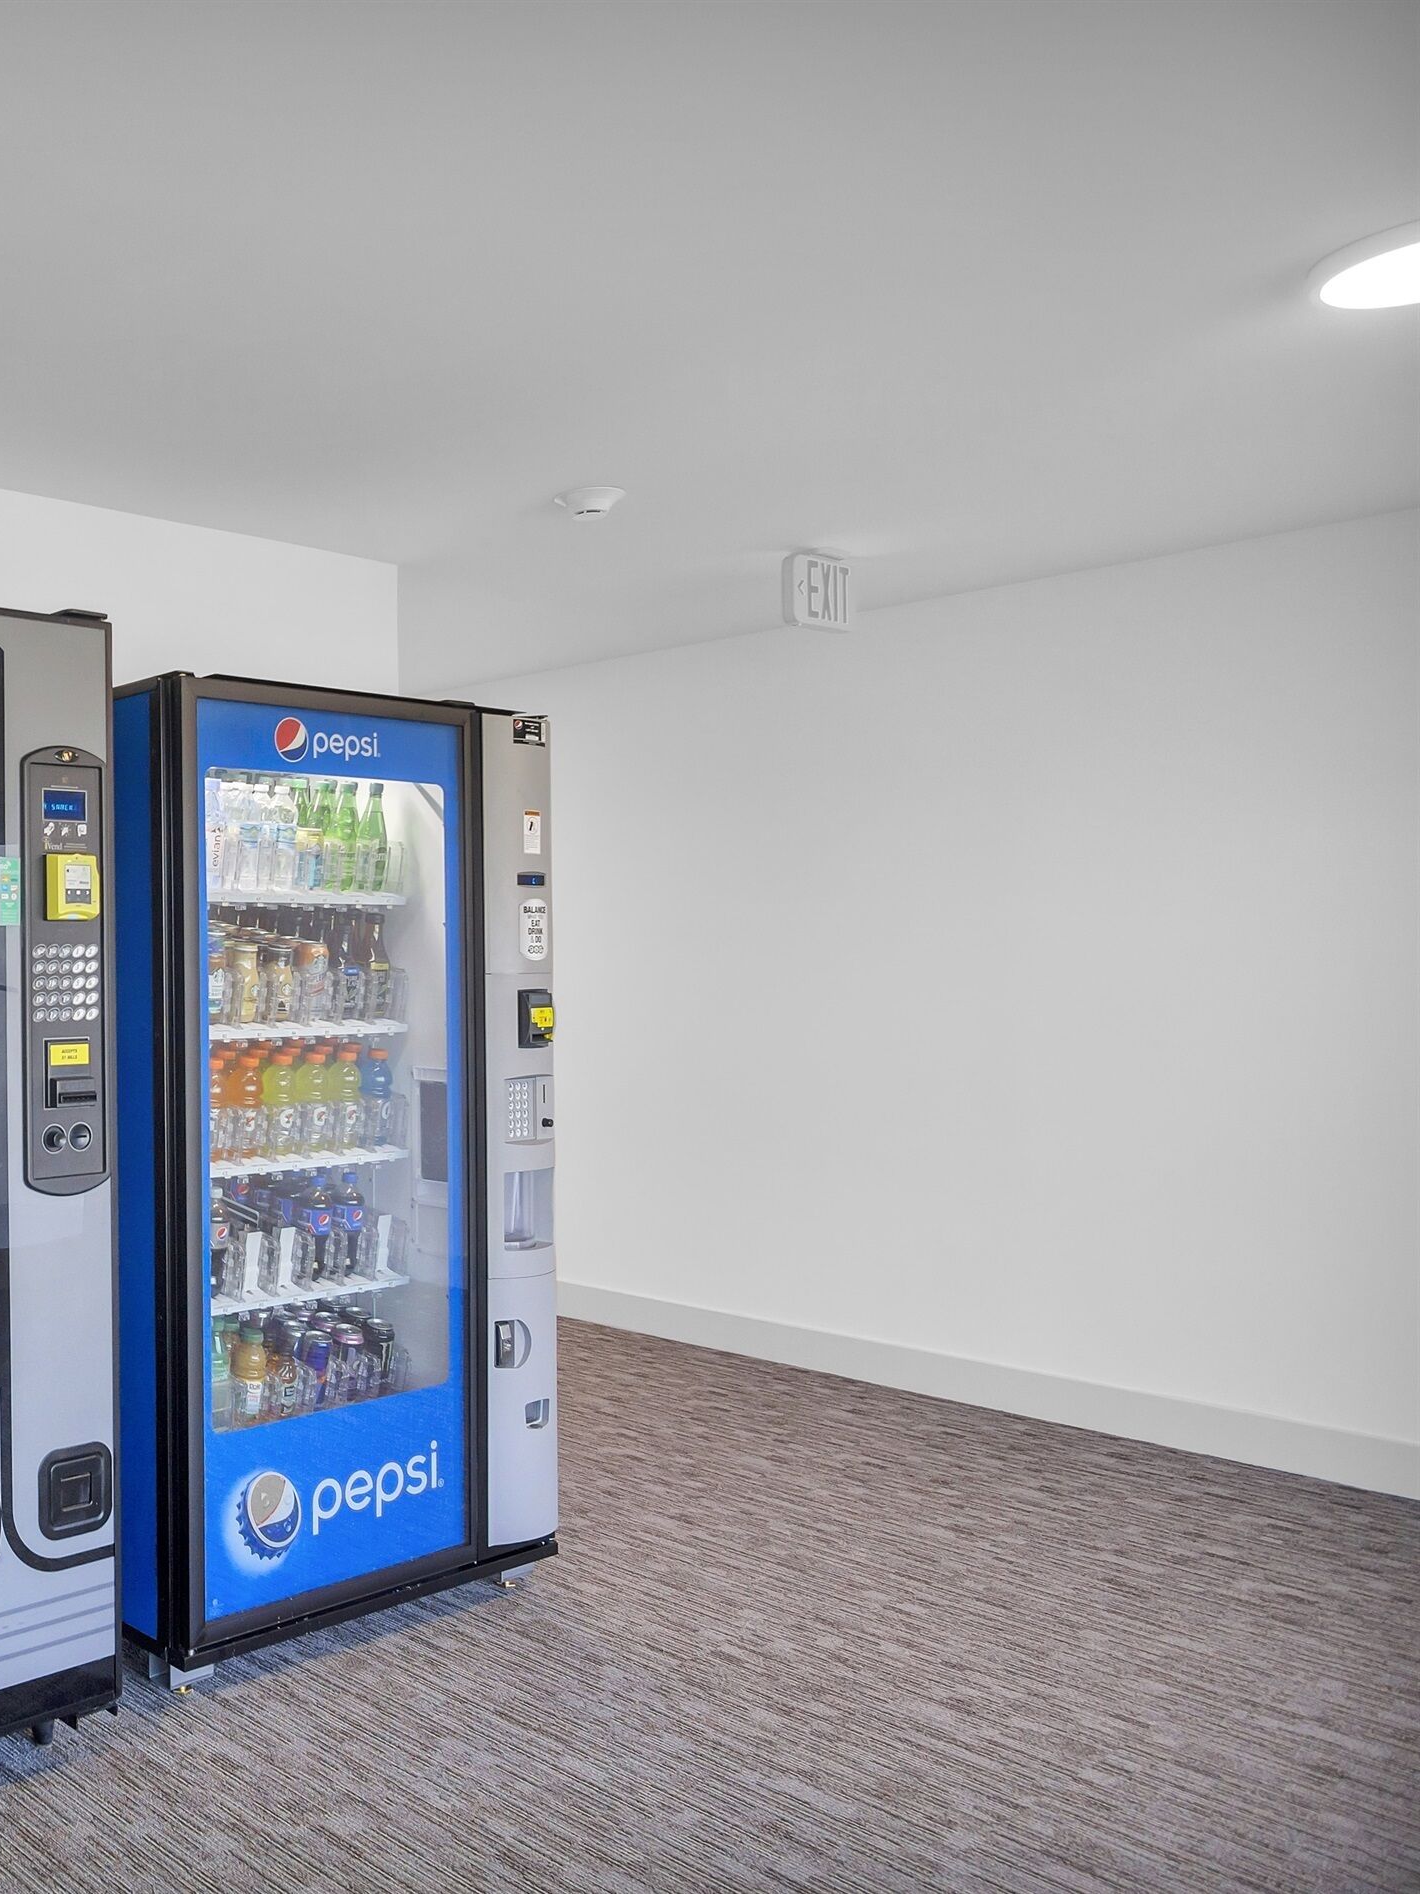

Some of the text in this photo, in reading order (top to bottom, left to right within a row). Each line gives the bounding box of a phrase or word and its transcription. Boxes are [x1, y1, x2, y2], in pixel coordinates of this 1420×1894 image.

[807, 560, 849, 623] EXIT
[313, 732, 378, 761] pepsi
[212, 834, 221, 867] evian
[523, 906, 546, 914] BALANCE
[531, 919, 540, 927] EAT
[528, 927, 543, 935] DRINK
[312, 1440, 438, 1536] pepsi
